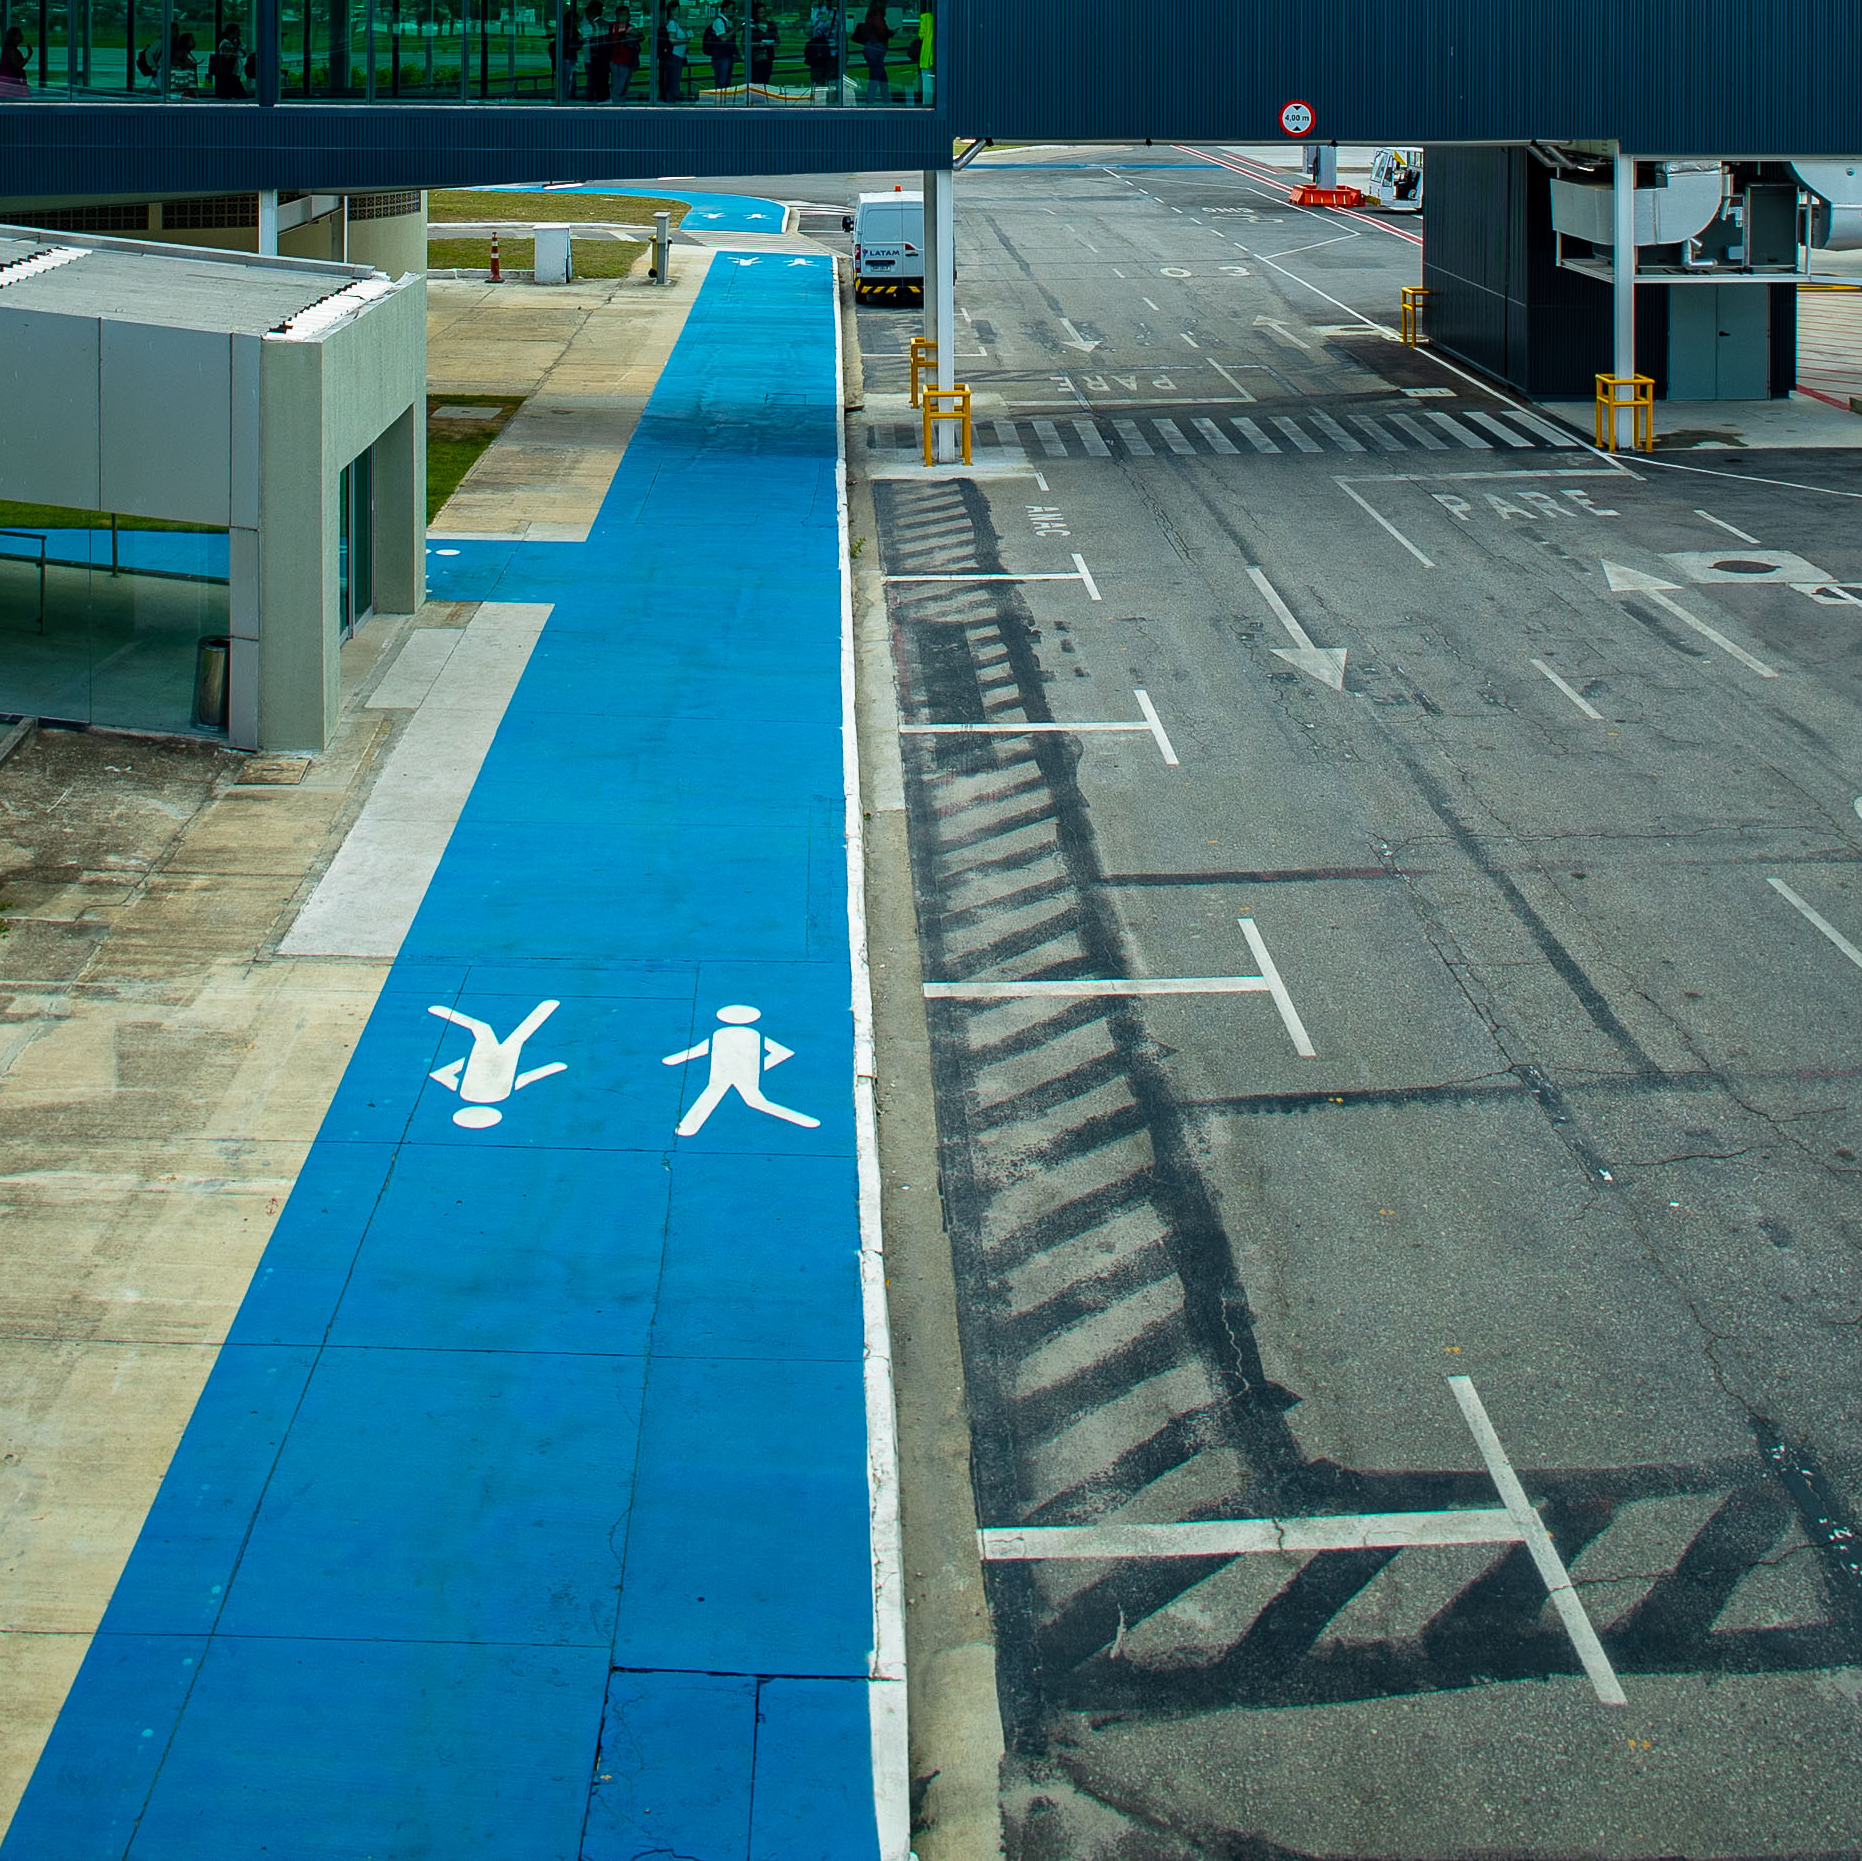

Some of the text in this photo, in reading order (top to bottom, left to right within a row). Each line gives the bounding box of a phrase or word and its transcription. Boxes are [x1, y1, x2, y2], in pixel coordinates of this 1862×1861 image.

[1050, 374, 1177, 392] PARE
[1025, 505, 1071, 537] ANAC
[1431, 490, 1622, 521] PARE
